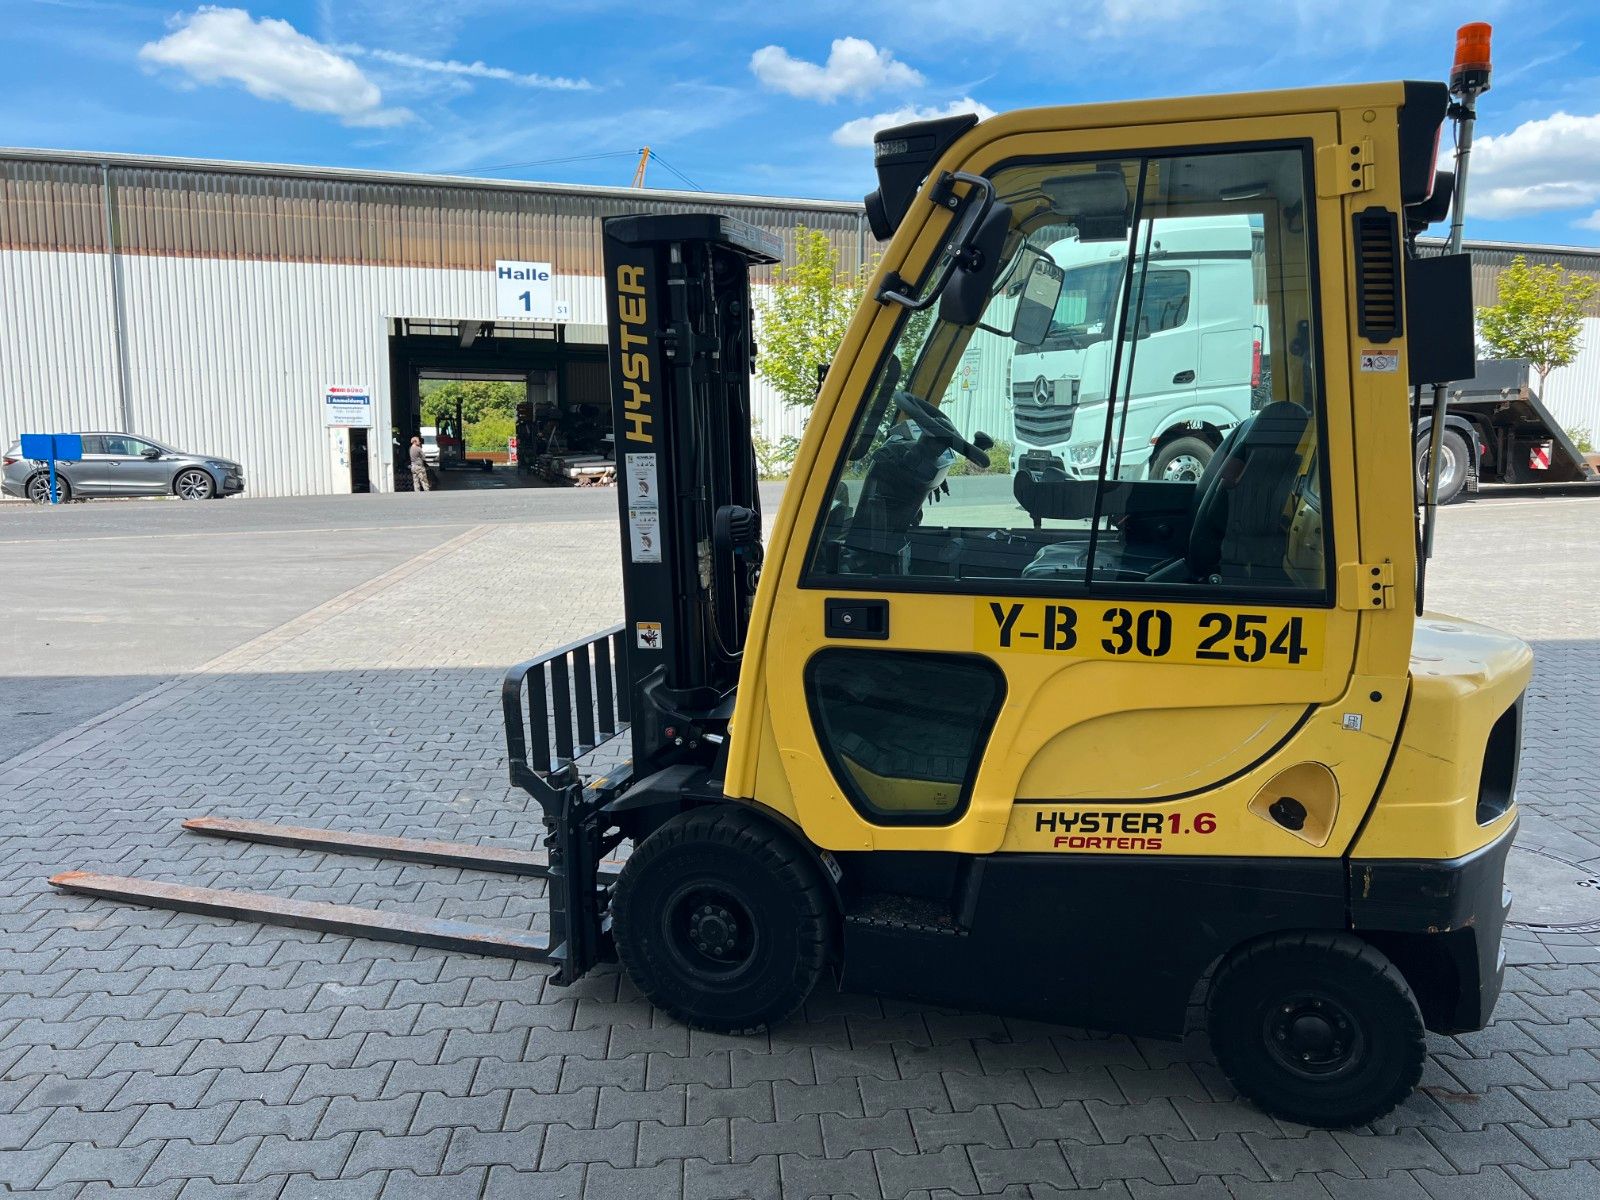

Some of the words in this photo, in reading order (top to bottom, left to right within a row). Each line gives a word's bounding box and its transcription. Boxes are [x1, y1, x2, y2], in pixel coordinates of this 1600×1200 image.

[498, 267, 549, 281] Halle
[519, 291, 531, 311] 1
[617, 264, 653, 443] HYSTER
[989, 602, 1078, 651] Y-B
[1101, 607, 1173, 657] 30
[1196, 612, 1308, 664] 254
[1035, 811, 1164, 834] HYSTER
[1167, 812, 1217, 835] 1.6
[1053, 836, 1162, 850] FORTENS
